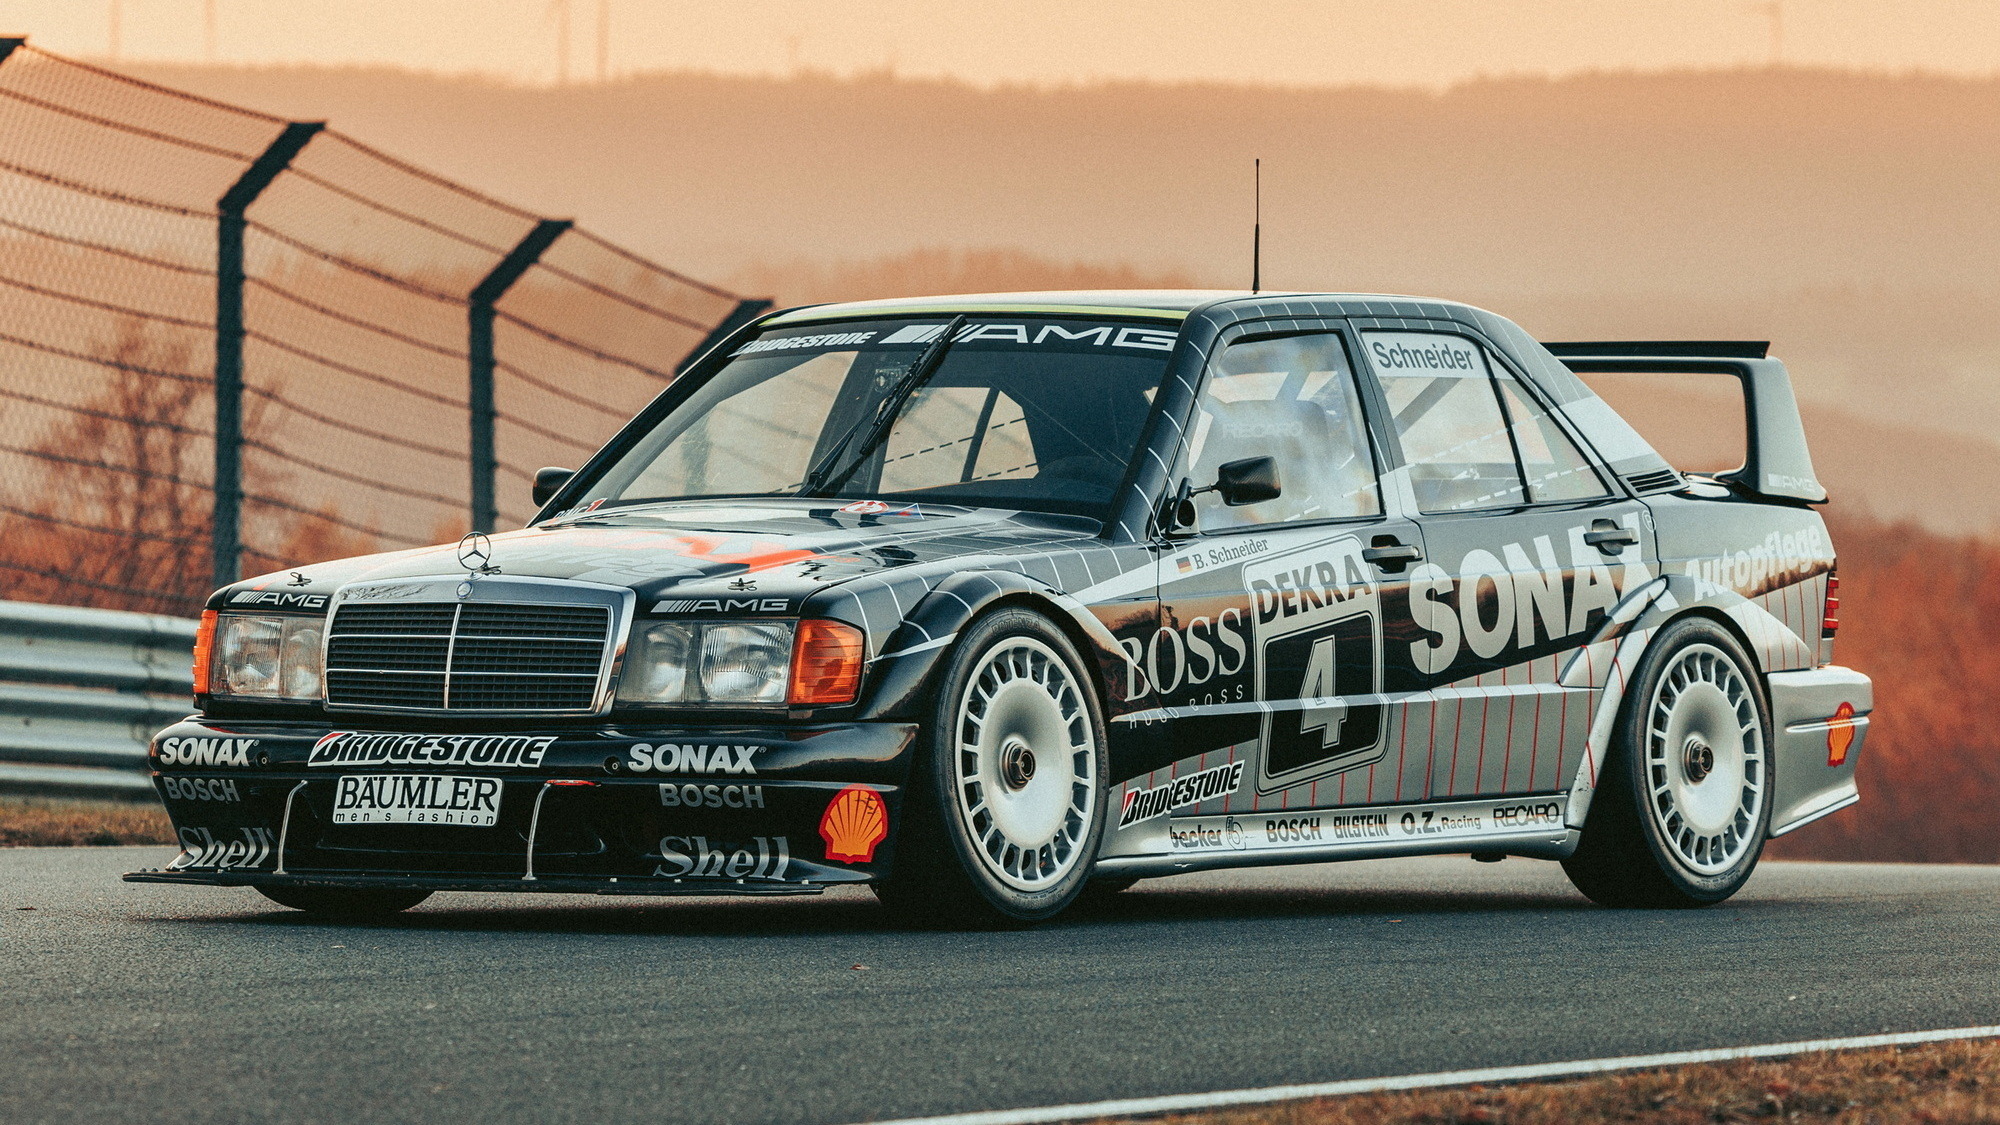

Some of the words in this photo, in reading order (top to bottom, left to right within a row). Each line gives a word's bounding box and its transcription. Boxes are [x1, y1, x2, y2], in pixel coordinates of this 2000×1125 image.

[728, 331, 877, 358] BRIDGESTONE
[962, 324, 1178, 351] AMG
[1371, 340, 1477, 371] Schneider
[1192, 554, 1209, 570] B.
[1211, 538, 1269, 566] Schneider
[1685, 525, 1825, 602] Autopflege
[263, 591, 329, 608] AMG
[692, 598, 790, 612] AMG
[1251, 554, 1372, 625] DEKRA
[1120, 607, 1247, 702] BOSS
[1128, 706, 1180, 729] HUGO
[1188, 684, 1244, 712] BOSS
[1299, 634, 1348, 750] 4
[309, 732, 557, 768] BRIDGESTONE
[162, 777, 240, 802] BOSCH
[339, 776, 497, 814] BÄUMLER
[659, 783, 765, 809] BOSCH
[335, 811, 392, 823] men's
[408, 810, 494, 825] fashion
[1169, 824, 1223, 849] becker
[1266, 817, 1323, 843] BOSCH
[1334, 812, 1390, 840] BILSTEIN
[1493, 802, 1560, 828] RECARO
[167, 827, 270, 871] Shell
[653, 836, 791, 882] Shell
